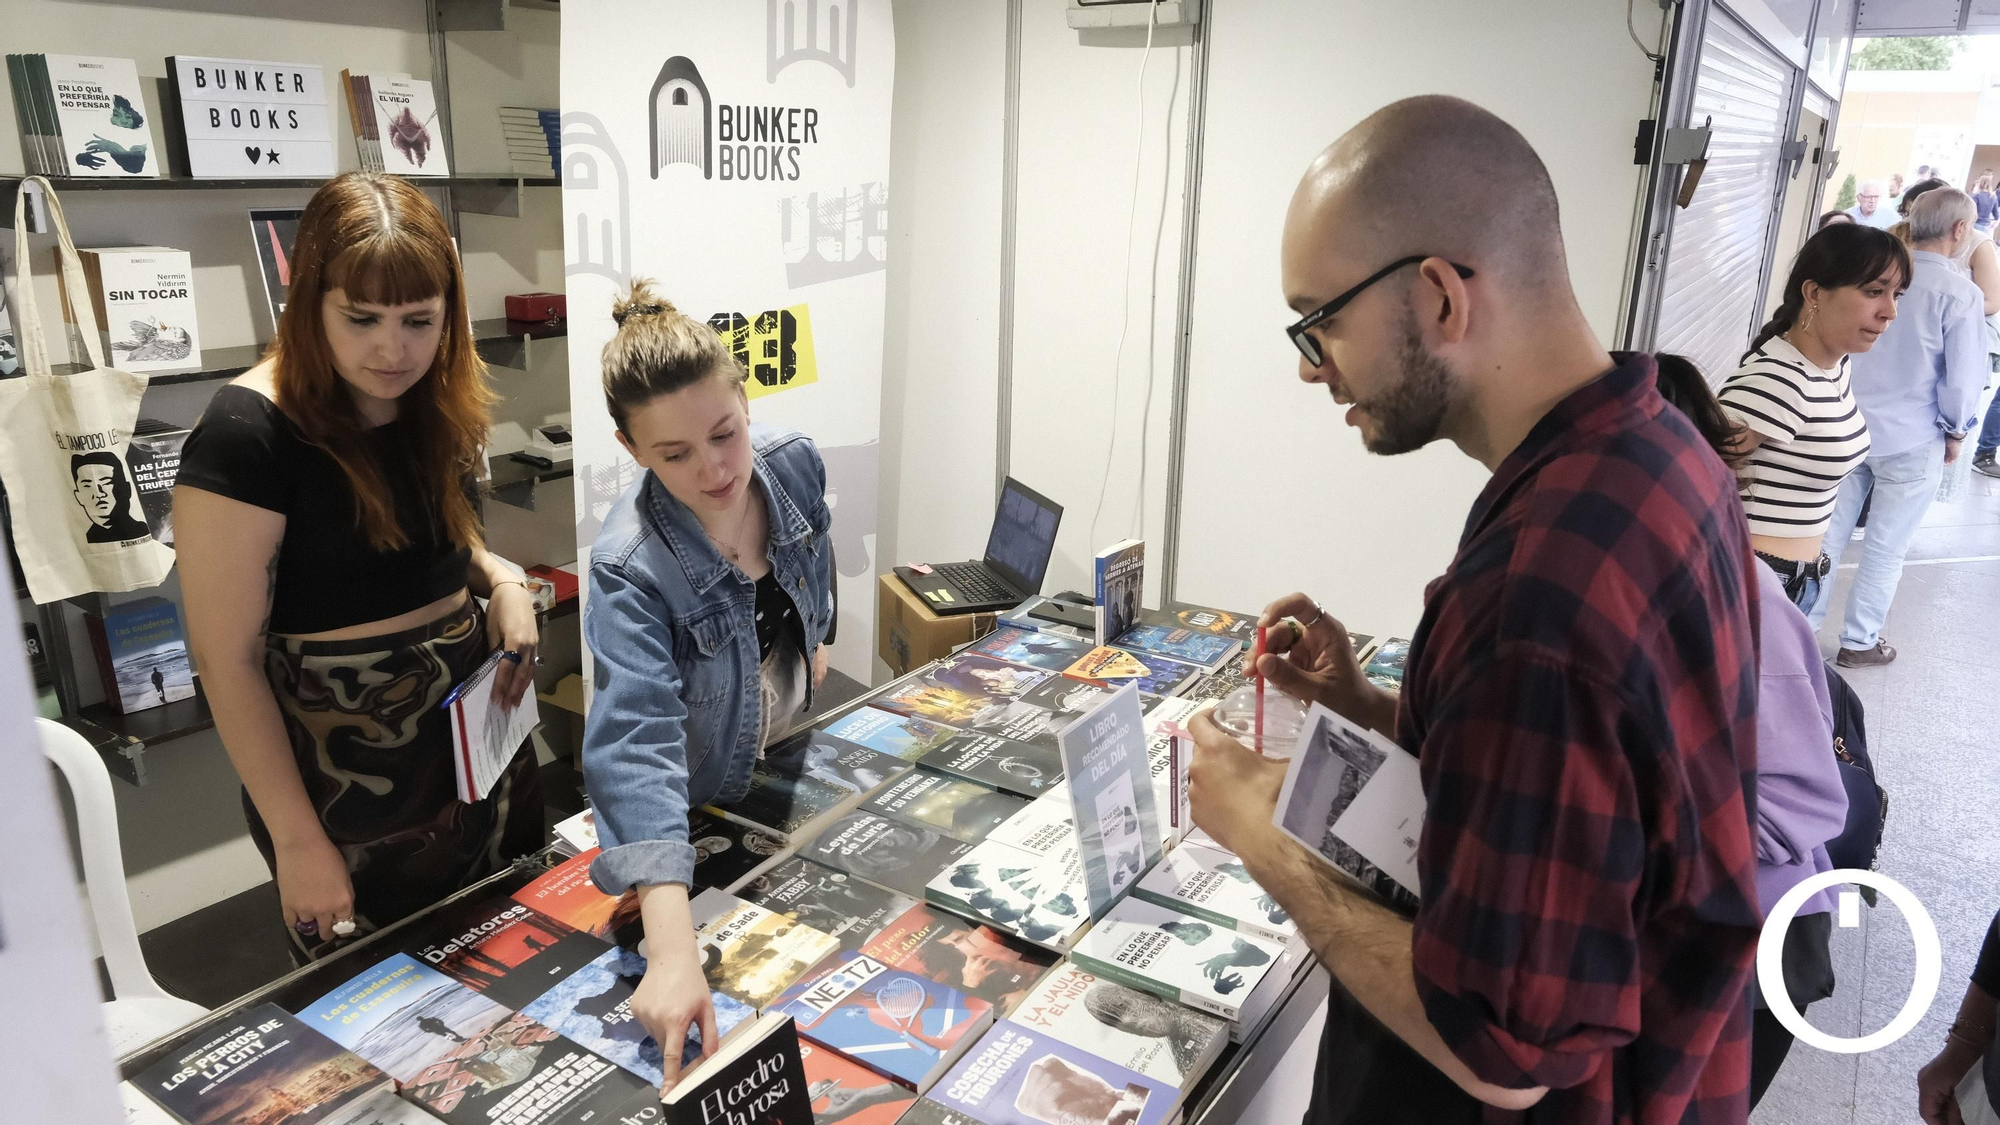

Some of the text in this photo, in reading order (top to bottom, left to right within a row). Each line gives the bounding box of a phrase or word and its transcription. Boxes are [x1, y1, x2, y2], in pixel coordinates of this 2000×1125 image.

[85, 86, 103, 94] QUE
[195, 68, 305, 92] BUNKER
[60, 92, 111, 101] PREFERIRÍA
[388, 96, 410, 104] VIEJO
[210, 108, 298, 130] BOOKS
[719, 104, 818, 144] BUNKER
[719, 144, 800, 181] BOOKS
[109, 288, 189, 301] SIN TOCAR
[66, 432, 106, 451] TAMPOCO
[134, 463, 154, 472] LAS
[136, 468, 180, 482] DEL CER
[1127, 560, 1145, 572] ATENAS
[1089, 712, 1118, 743] LIBRO
[1082, 724, 1130, 766] RECOMENDADO
[1091, 744, 1128, 782] DEL DÍA
[874, 772, 924, 806] MONTENEGRO
[885, 805, 896, 814] Y
[894, 794, 908, 808] SU
[818, 814, 877, 855] Leyendas
[840, 822, 888, 856] de Luria
[535, 889, 550, 900] El
[548, 868, 582, 891] hombre
[557, 885, 572, 896] del
[776, 878, 811, 902] FABBY
[1177, 870, 1207, 898] EN LO QUE
[1197, 874, 1229, 904] NO PENSAR
[424, 904, 528, 964] Delatores
[700, 902, 750, 938] Sombras
[716, 910, 760, 943] de Sade
[416, 944, 436, 958] Los
[468, 931, 492, 951] Arturo
[866, 926, 906, 959] El peso
[902, 924, 931, 950] dolor
[1116, 930, 1150, 962] EN LO QUE
[1126, 931, 1164, 966] PREFERIRÍA
[1138, 935, 1173, 970] NO PENSAR
[320, 964, 416, 1022] Los cuadernos
[362, 970, 384, 985] VELLA
[1024, 970, 1080, 1022] LA JAULA
[1036, 974, 1097, 1028] Y EL NIDO
[341, 1010, 362, 1025] de
[602, 1010, 620, 1022] EL
[162, 1018, 284, 1091] LOS PERROS DE
[179, 1049, 204, 1065] MARCO
[202, 1039, 266, 1080] LA CITY
[570, 1054, 598, 1070] EN
[946, 1037, 1010, 1100] COSECHA
[1002, 1030, 1017, 1043] DE
[1125, 1046, 1147, 1070] Emilio
[1136, 1041, 1164, 1073] del Rosal
[486, 1052, 580, 1120] SIEMPRE ES
[960, 1036, 1035, 1106] TIBURONES
[507, 1060, 608, 1125] ARCELONA
[700, 1052, 785, 1125] El cedro
[746, 1078, 791, 1122] rosa
